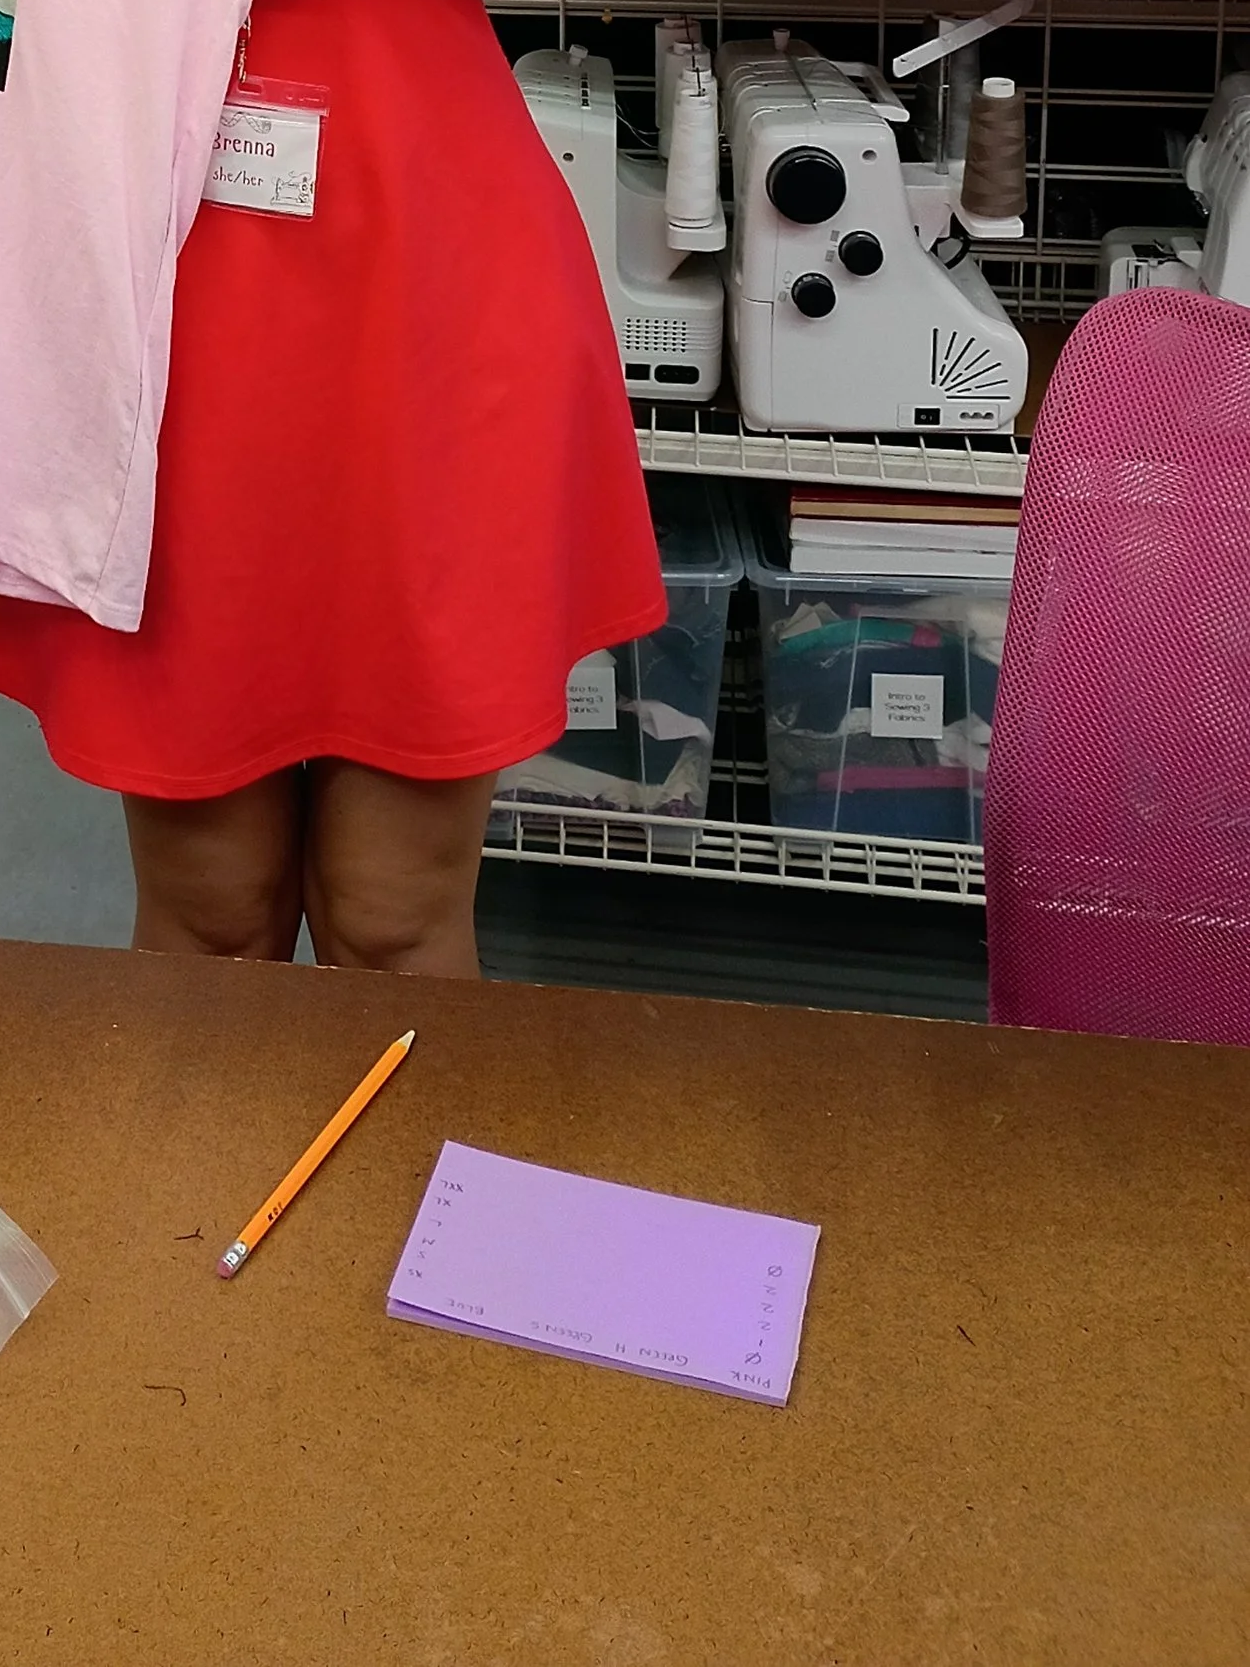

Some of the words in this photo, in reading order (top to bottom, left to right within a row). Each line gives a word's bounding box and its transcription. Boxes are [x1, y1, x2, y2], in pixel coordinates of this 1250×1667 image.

[212, 132, 275, 157] Brenna
[212, 166, 264, 187] she/her
[888, 692, 912, 701] Intro
[914, 693, 926, 701] to
[884, 702, 921, 714] Sewing
[923, 703, 931, 712] 3
[888, 713, 926, 722] Fabrics
[440, 1179, 464, 1193] XXL
[435, 1197, 452, 1207] XL
[408, 1269, 423, 1278] XS
[448, 1297, 485, 1315] BLUE
[760, 1302, 775, 1314] 2
[757, 1320, 772, 1331] 2
[546, 1324, 593, 1343] GREEN
[638, 1347, 689, 1367] GREEN
[730, 1370, 771, 1389] PINK
